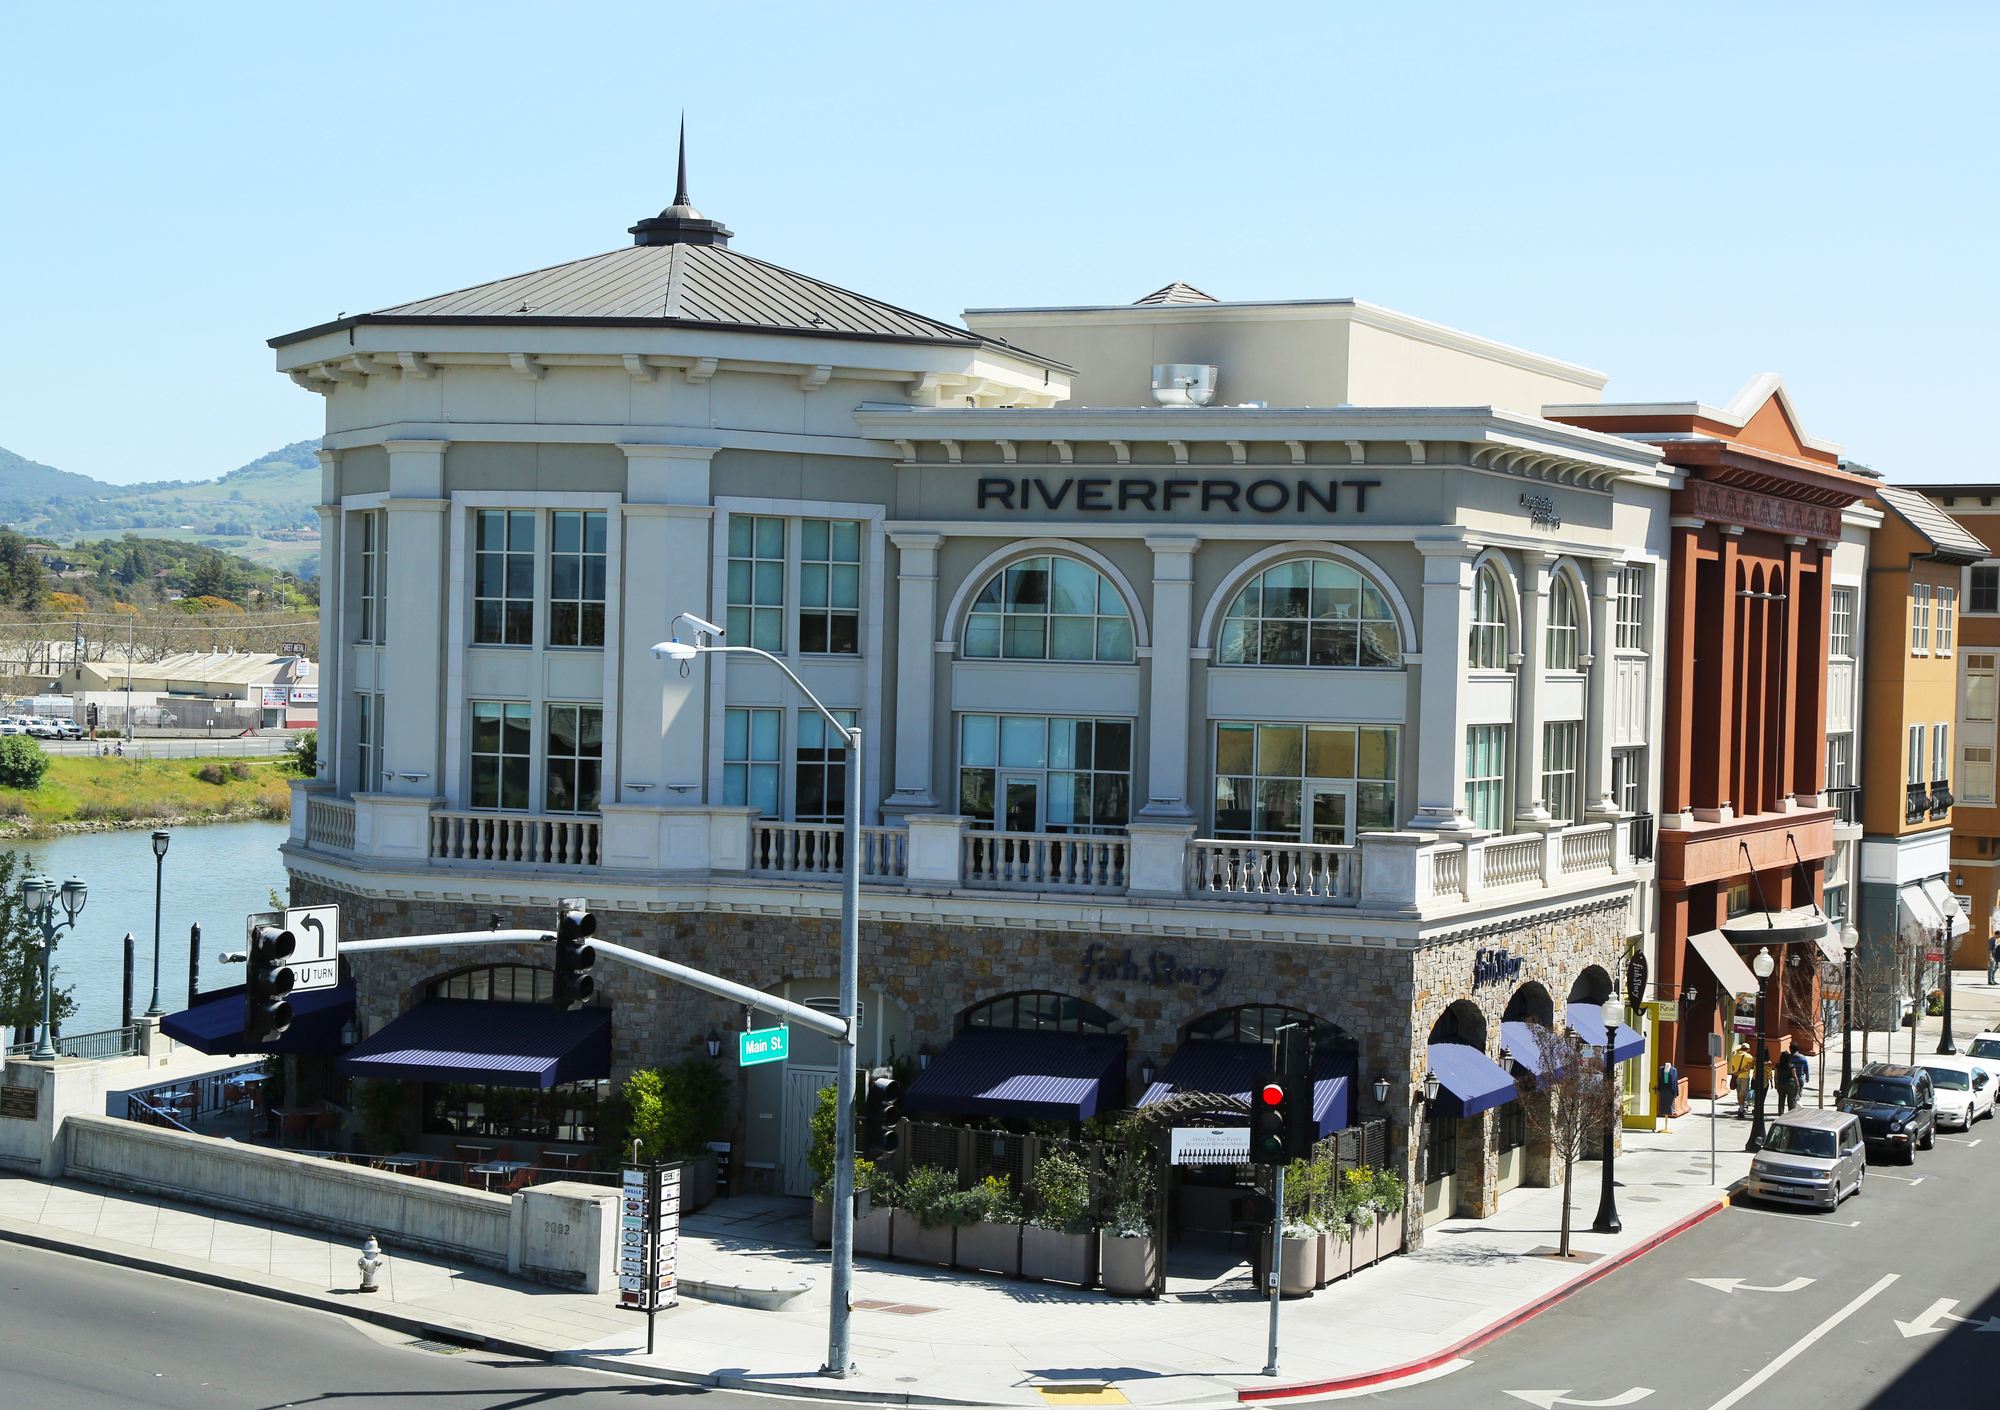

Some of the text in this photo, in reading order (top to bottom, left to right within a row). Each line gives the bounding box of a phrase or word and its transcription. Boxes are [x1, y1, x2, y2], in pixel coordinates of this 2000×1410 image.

[977, 478, 1381, 513] RIVERFRONT
[301, 968, 310, 983] U
[313, 968, 333, 980] TURN
[1078, 943, 1228, 996] fish Story
[1660, 1003, 1675, 1012] Real
[746, 1036, 783, 1054] Main St.
[544, 1221, 570, 1235] 2002
